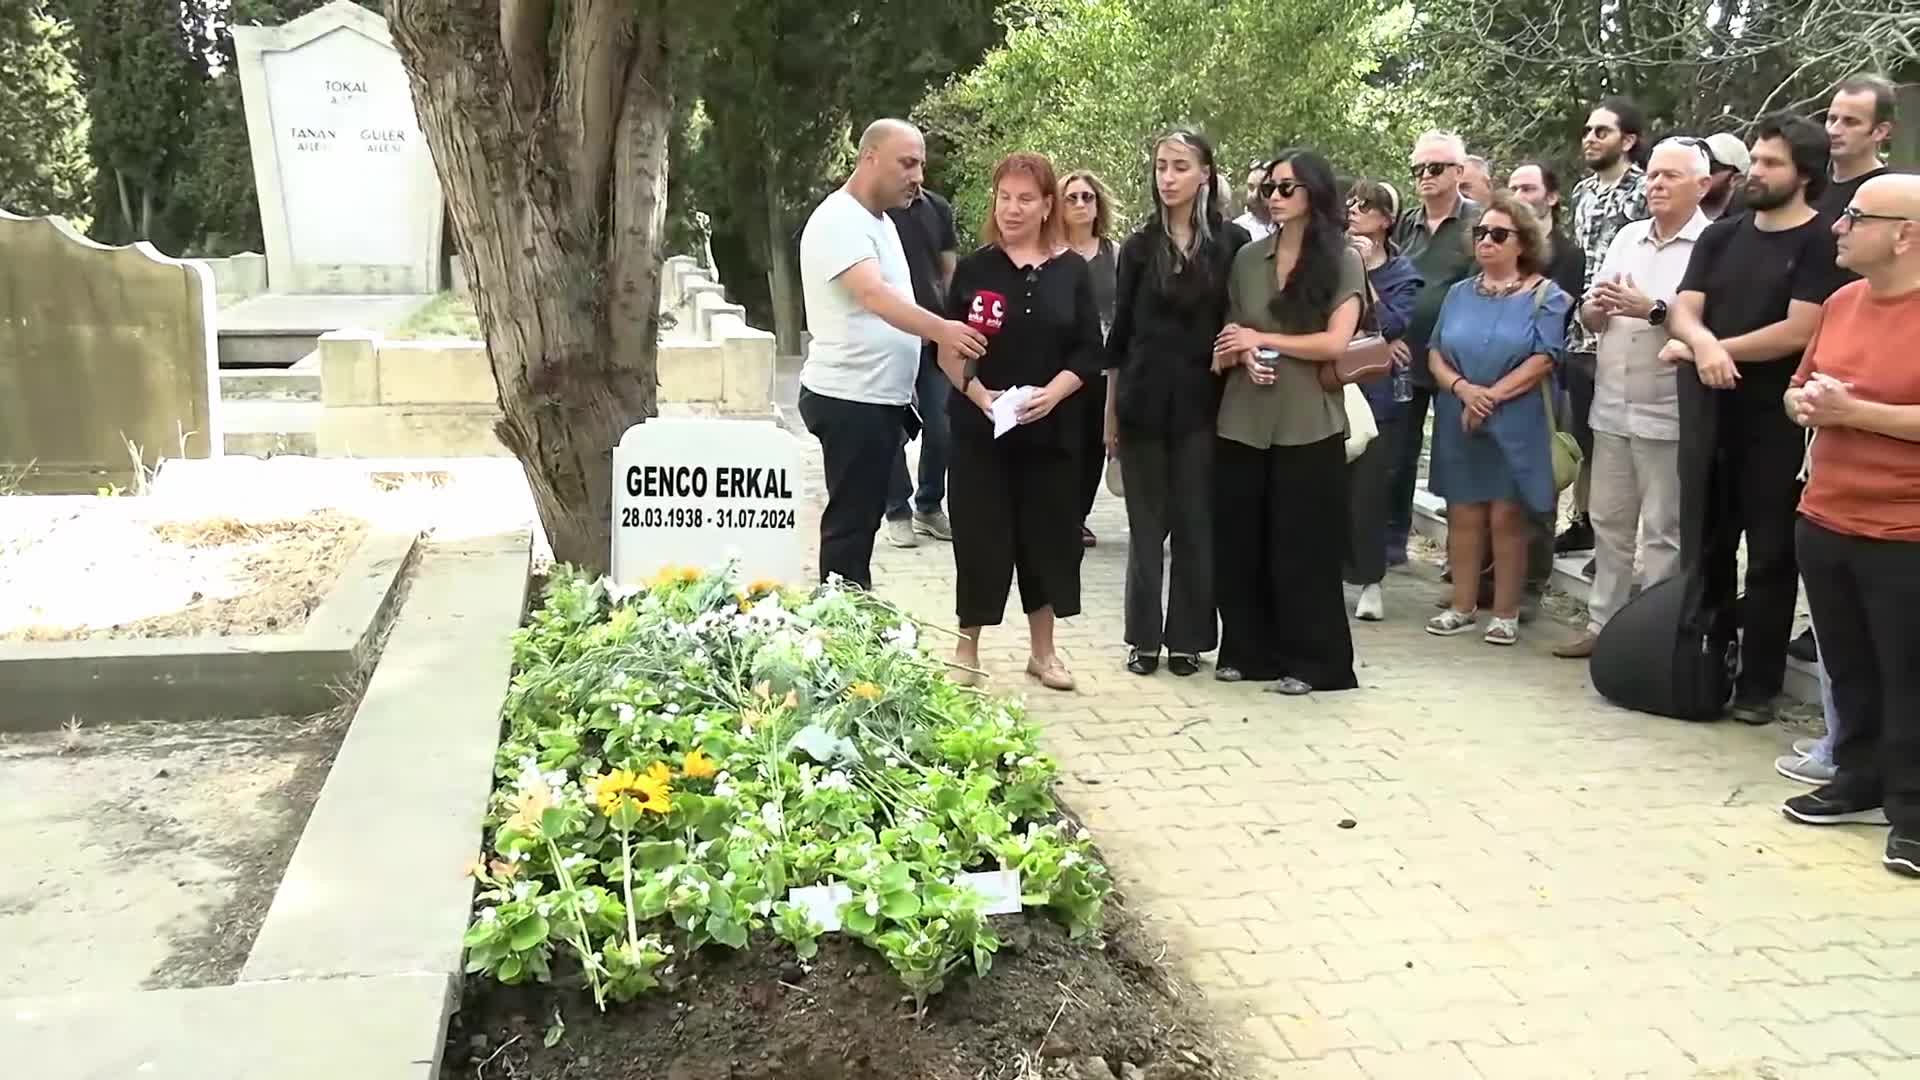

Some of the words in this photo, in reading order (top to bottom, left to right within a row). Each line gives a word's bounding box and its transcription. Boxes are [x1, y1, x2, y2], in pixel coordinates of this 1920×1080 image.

[325, 80, 368, 93] TOKAL
[626, 465, 708, 497] GENCO
[716, 467, 793, 498] ERKAL
[622, 507, 703, 528] 28.03.1938
[716, 508, 796, 529] 31.07.2024
